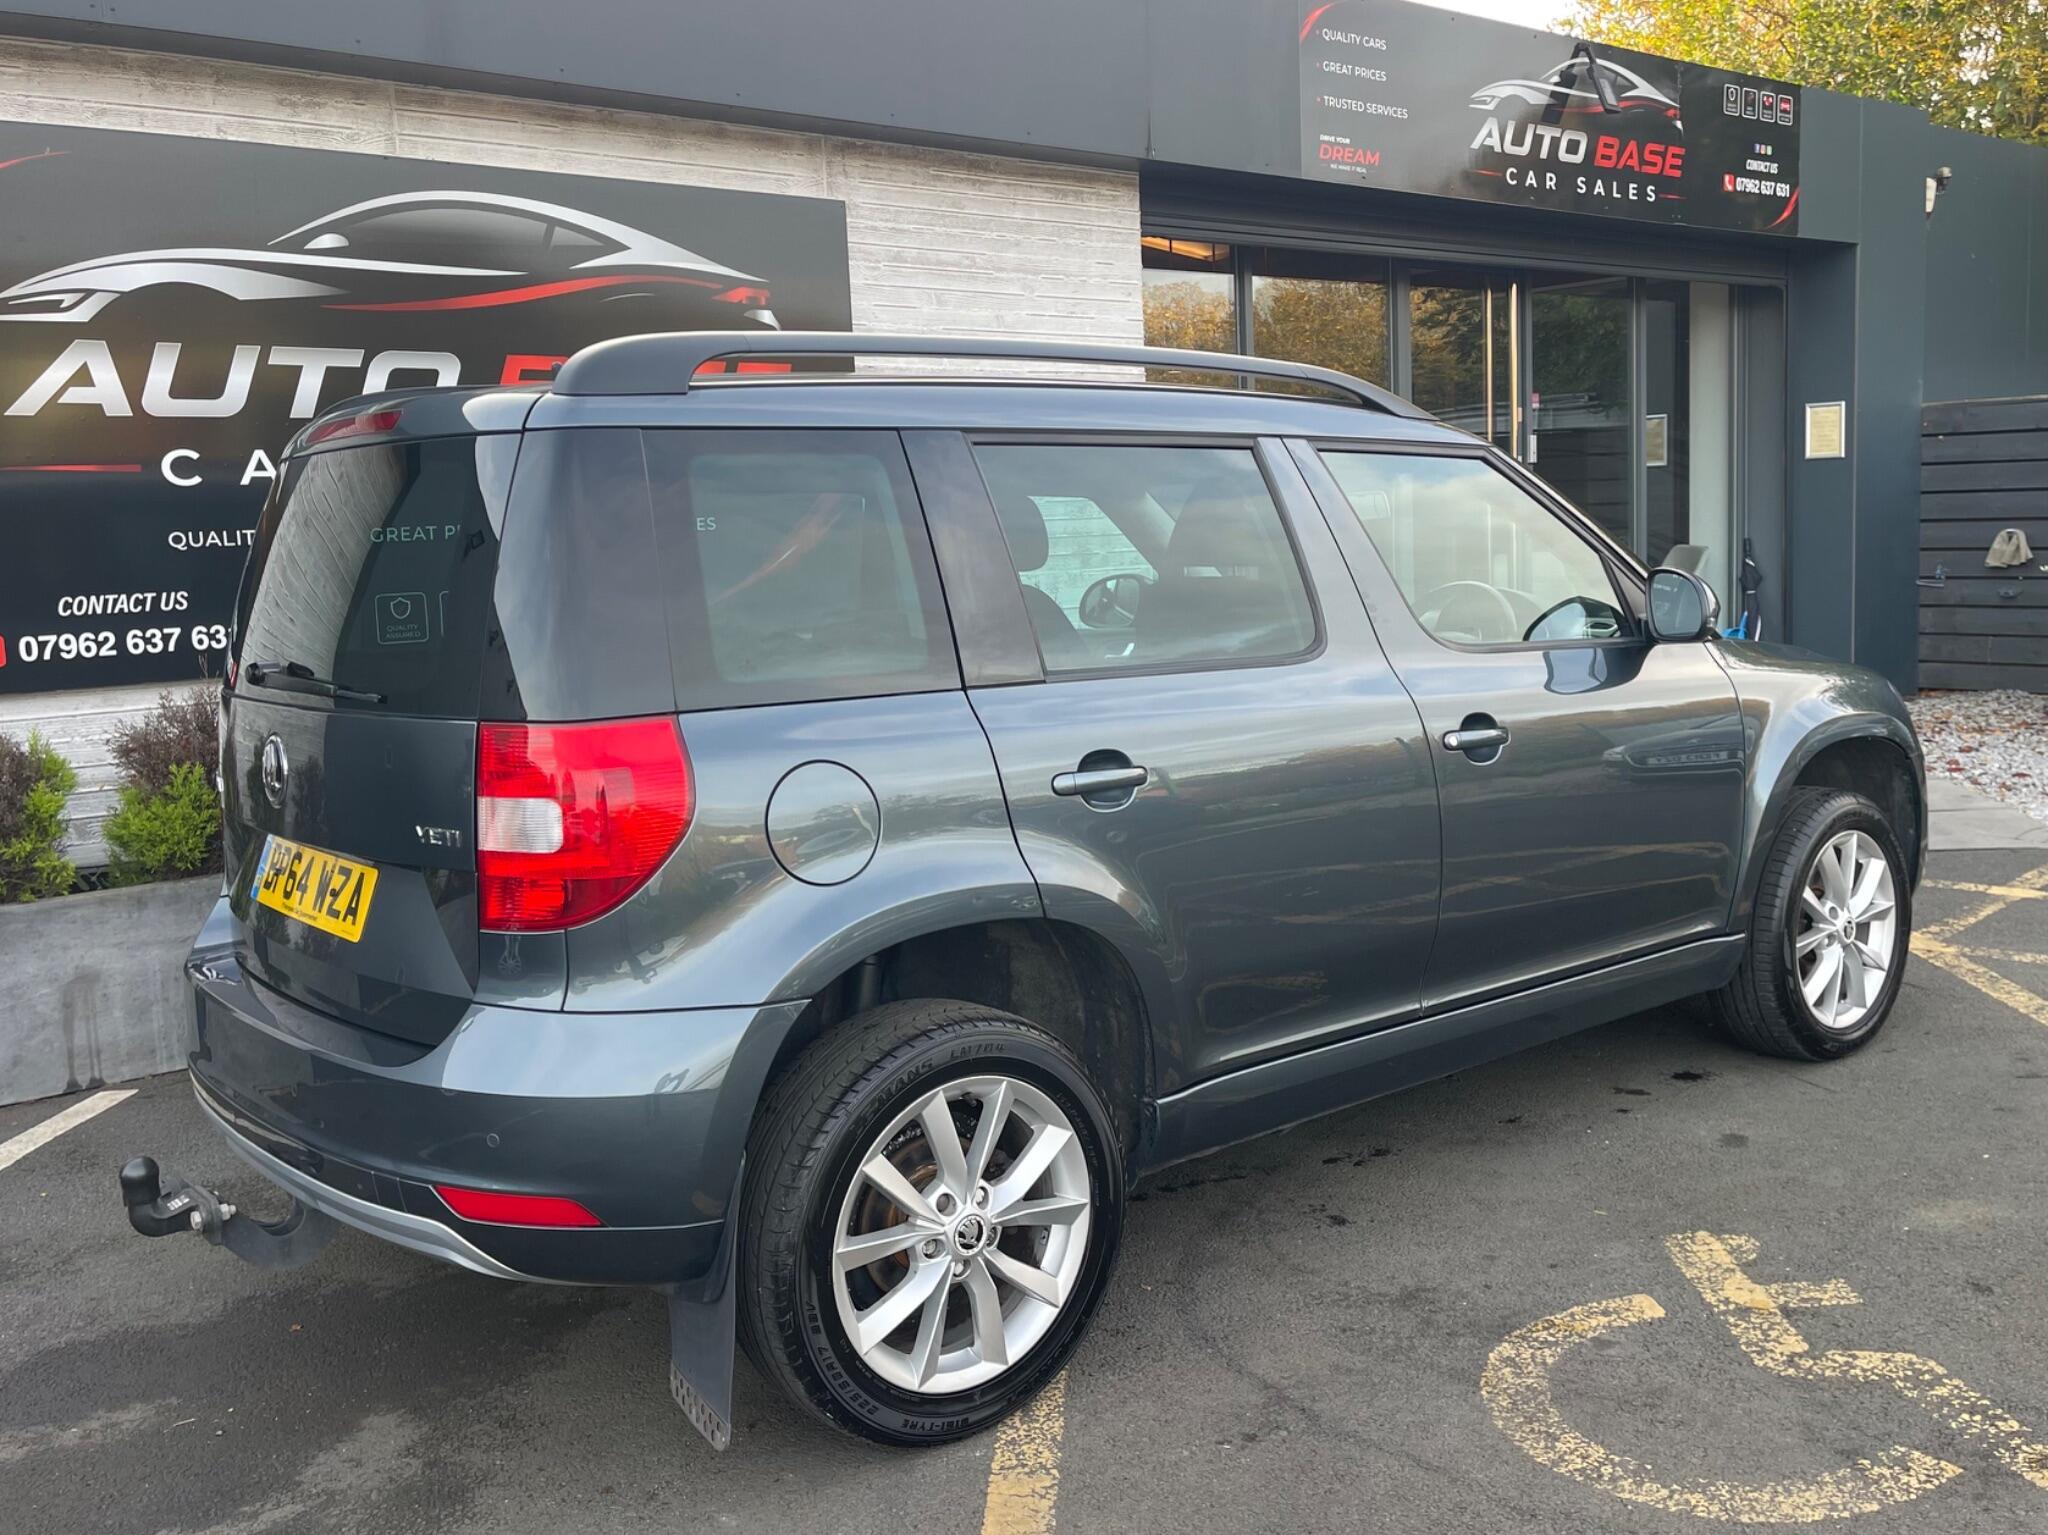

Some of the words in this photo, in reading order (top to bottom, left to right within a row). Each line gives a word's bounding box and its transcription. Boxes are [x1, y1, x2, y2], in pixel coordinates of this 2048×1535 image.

[1322, 28, 1361, 45] QUALITY
[1363, 36, 1387, 51] CARS
[1323, 60, 1353, 76] GREAT
[1354, 66, 1387, 82] PRICES
[1323, 95, 1365, 112] TRUSTED
[1366, 103, 1409, 119] SERVICES
[1319, 143, 1381, 166] DREAM
[1469, 116, 1589, 164] AUTO
[1594, 135, 1686, 178] BASE
[1746, 159, 1770, 173] CONTACT
[1770, 162, 1779, 174] US
[1505, 167, 1557, 190] CAR
[1576, 176, 1656, 202] SALES
[1736, 177, 1760, 194] 07962
[1760, 180, 1775, 195] 637
[1776, 182, 1790, 197] 631
[160, 448, 278, 487] CA
[168, 529, 257, 551] QUALIT
[370, 525, 437, 542] GREAT
[58, 592, 156, 617] CONTACT
[160, 591, 189, 611] US
[18, 630, 117, 662] 07962
[126, 627, 181, 655] 637
[191, 624, 231, 650] 63
[415, 825, 461, 848] YETI
[312, 858, 366, 926] WZA
